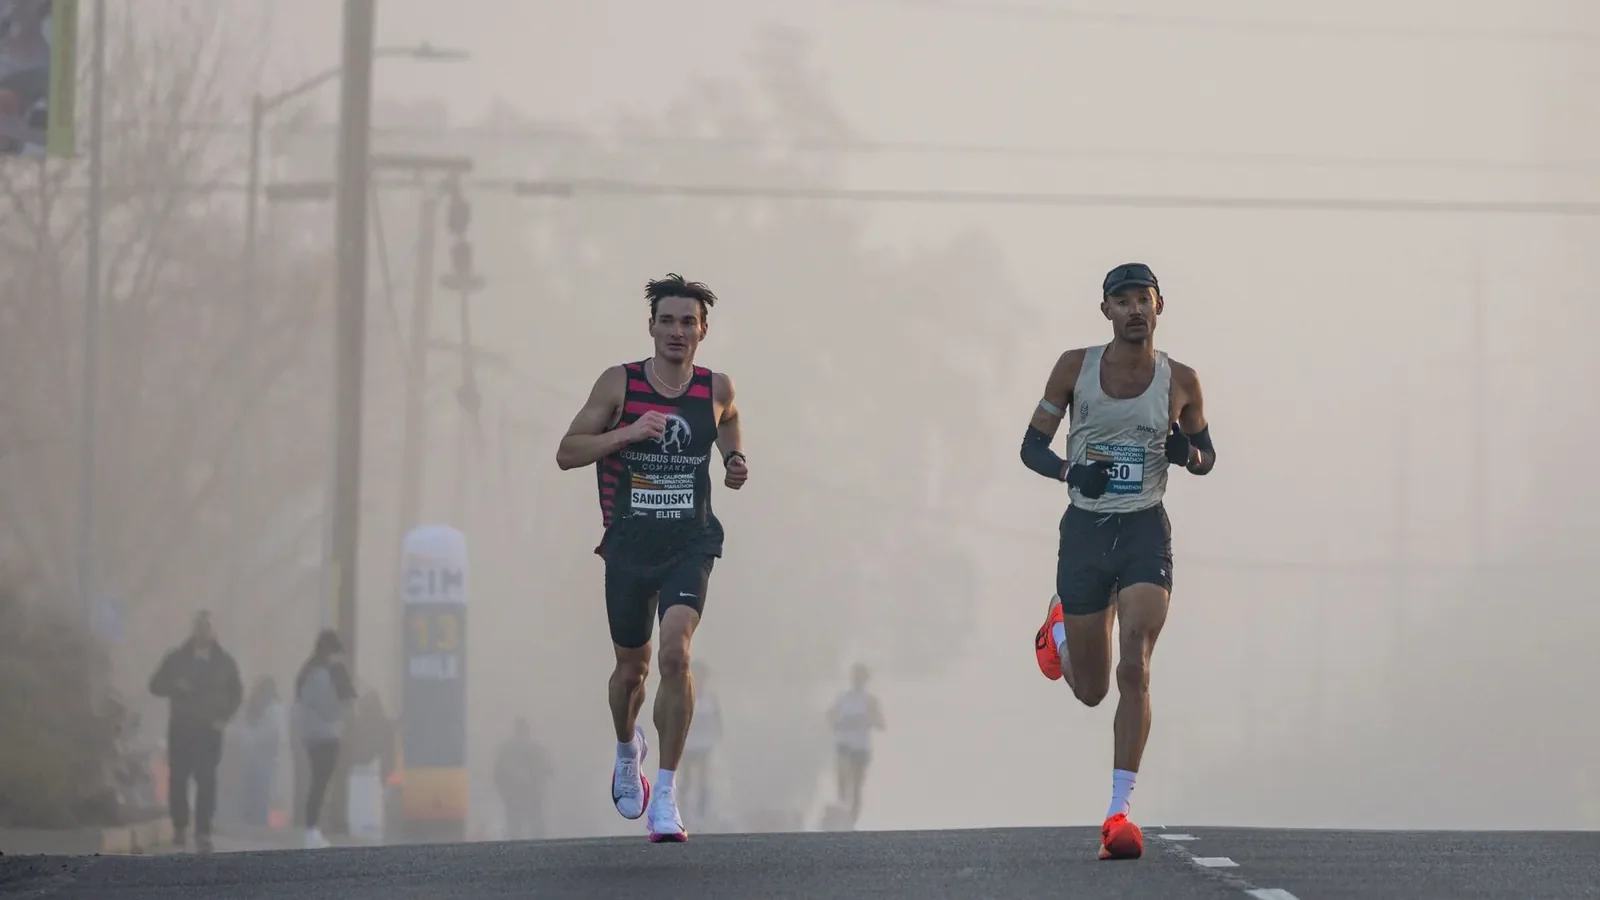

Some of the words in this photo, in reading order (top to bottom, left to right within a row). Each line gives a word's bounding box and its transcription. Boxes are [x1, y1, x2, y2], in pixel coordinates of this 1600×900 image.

[620, 451, 669, 463] COLUMBUS
[641, 463, 686, 472] COMPANY
[632, 492, 692, 505] SANDUSKY
[656, 510, 681, 519] ELITE
[405, 567, 463, 596] CIM
